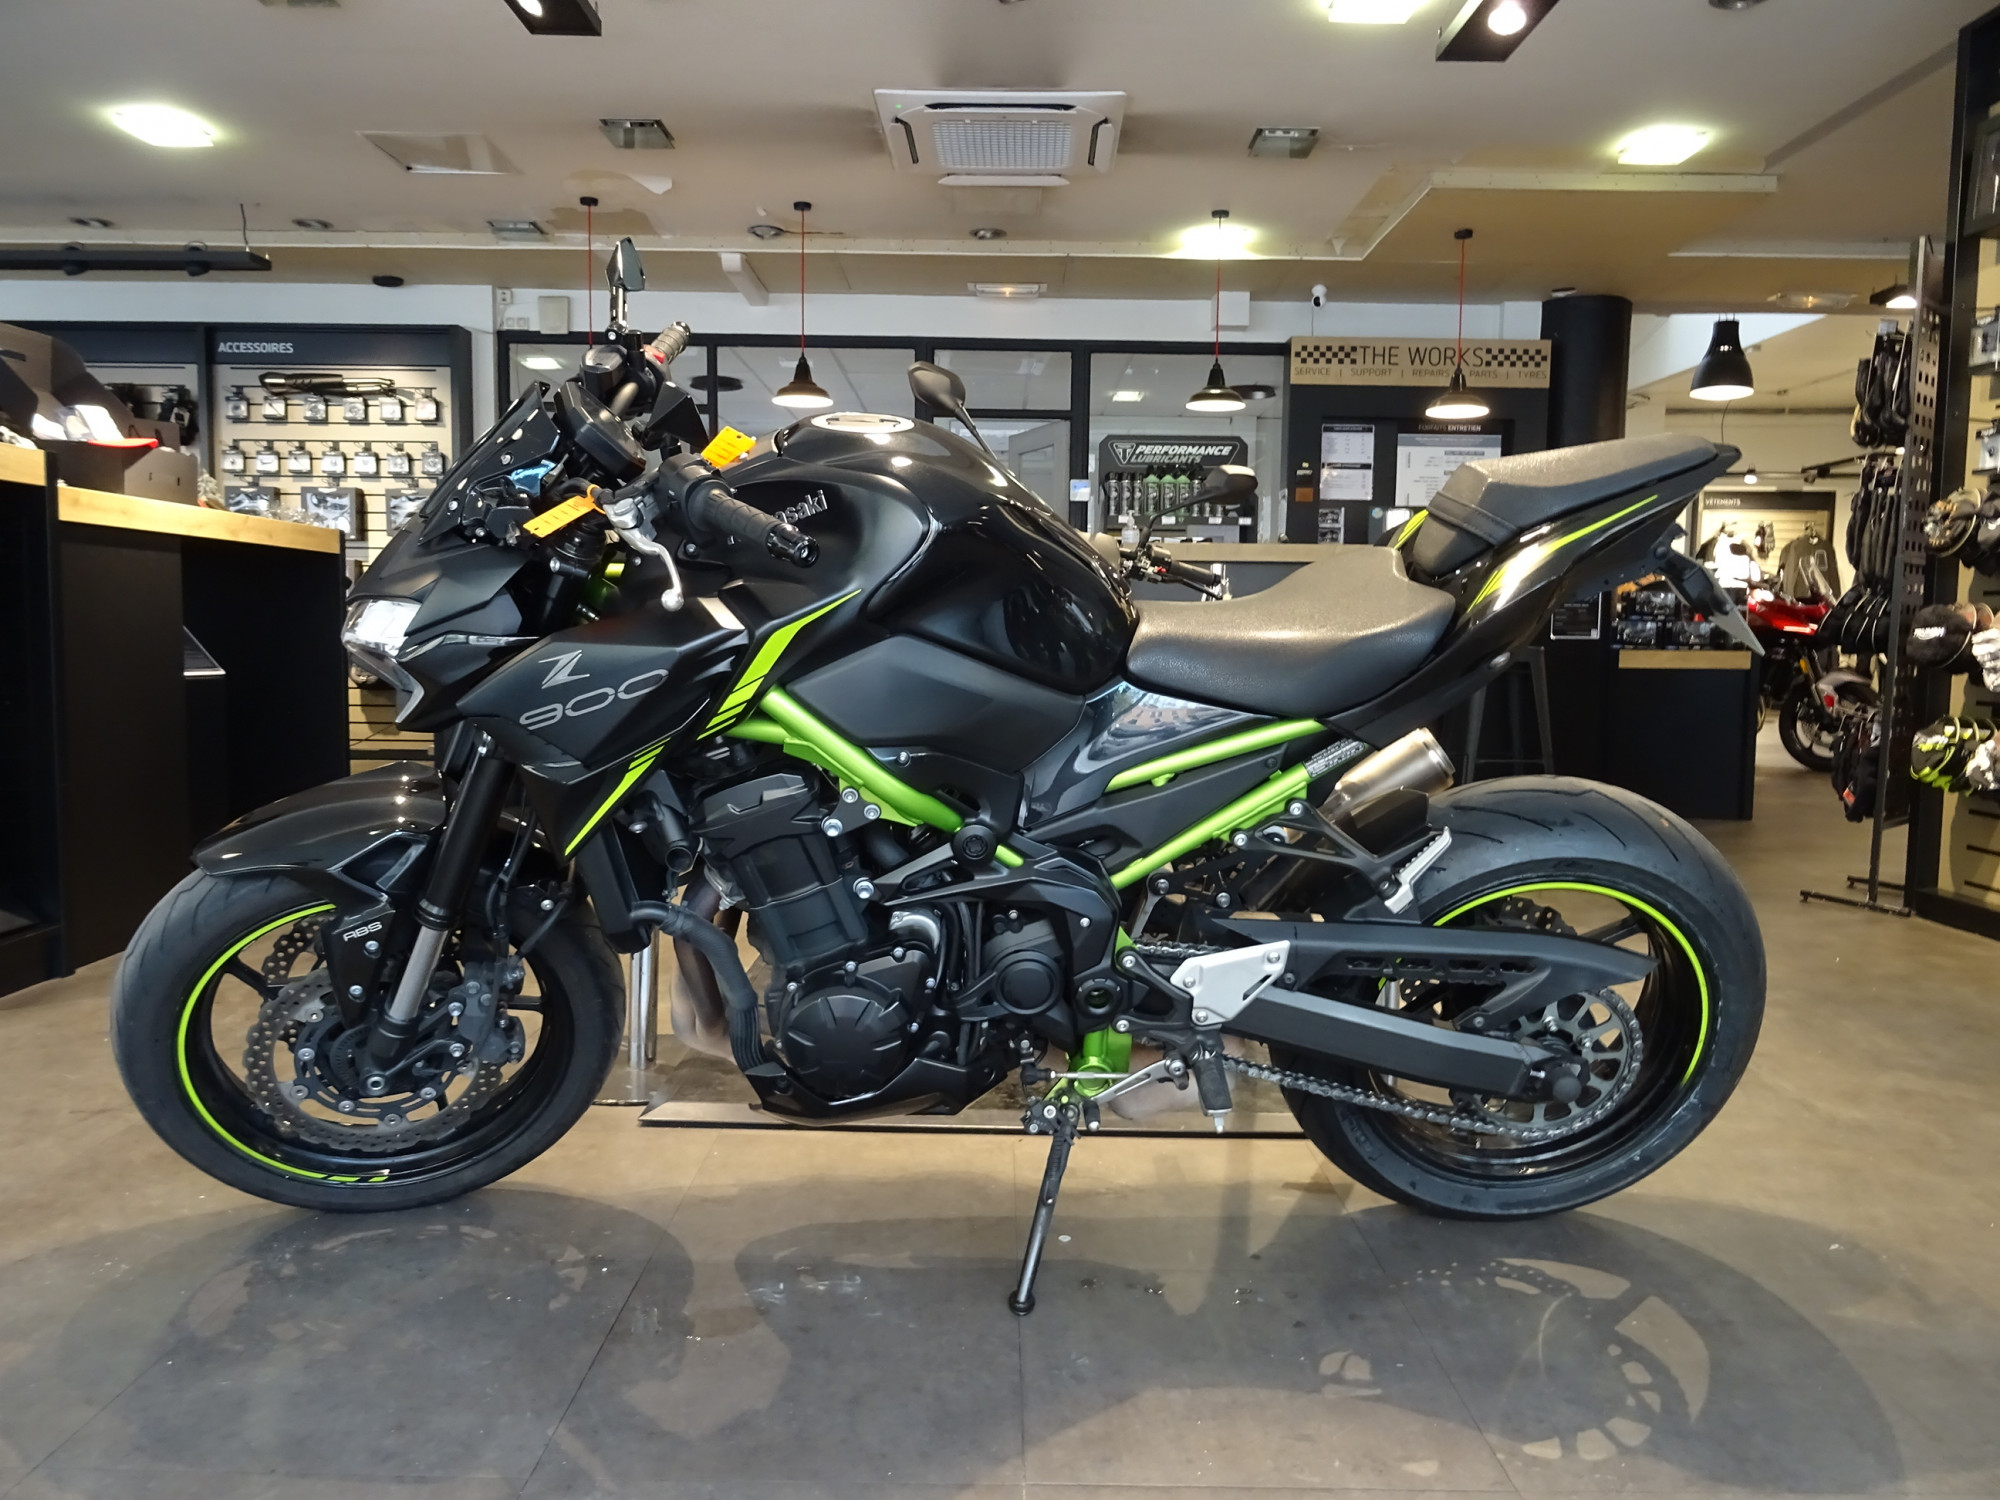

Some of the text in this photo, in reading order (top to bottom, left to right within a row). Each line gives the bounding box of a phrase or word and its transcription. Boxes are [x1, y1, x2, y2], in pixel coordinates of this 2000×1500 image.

[217, 341, 294, 354] ACCESSOIRES
[1359, 345, 1485, 367] THE WORKS
[1294, 367, 1547, 380] SERVICE SUPPORT REPAIRS PARTS TYRES
[1447, 424, 1482, 432] ENTRETIEN
[1135, 444, 1232, 456] PERFORMANCE
[1130, 454, 1203, 464] LUBRICANTS
[538, 649, 590, 690] Z
[519, 668, 669, 731] 900
[342, 921, 383, 942] ABS
